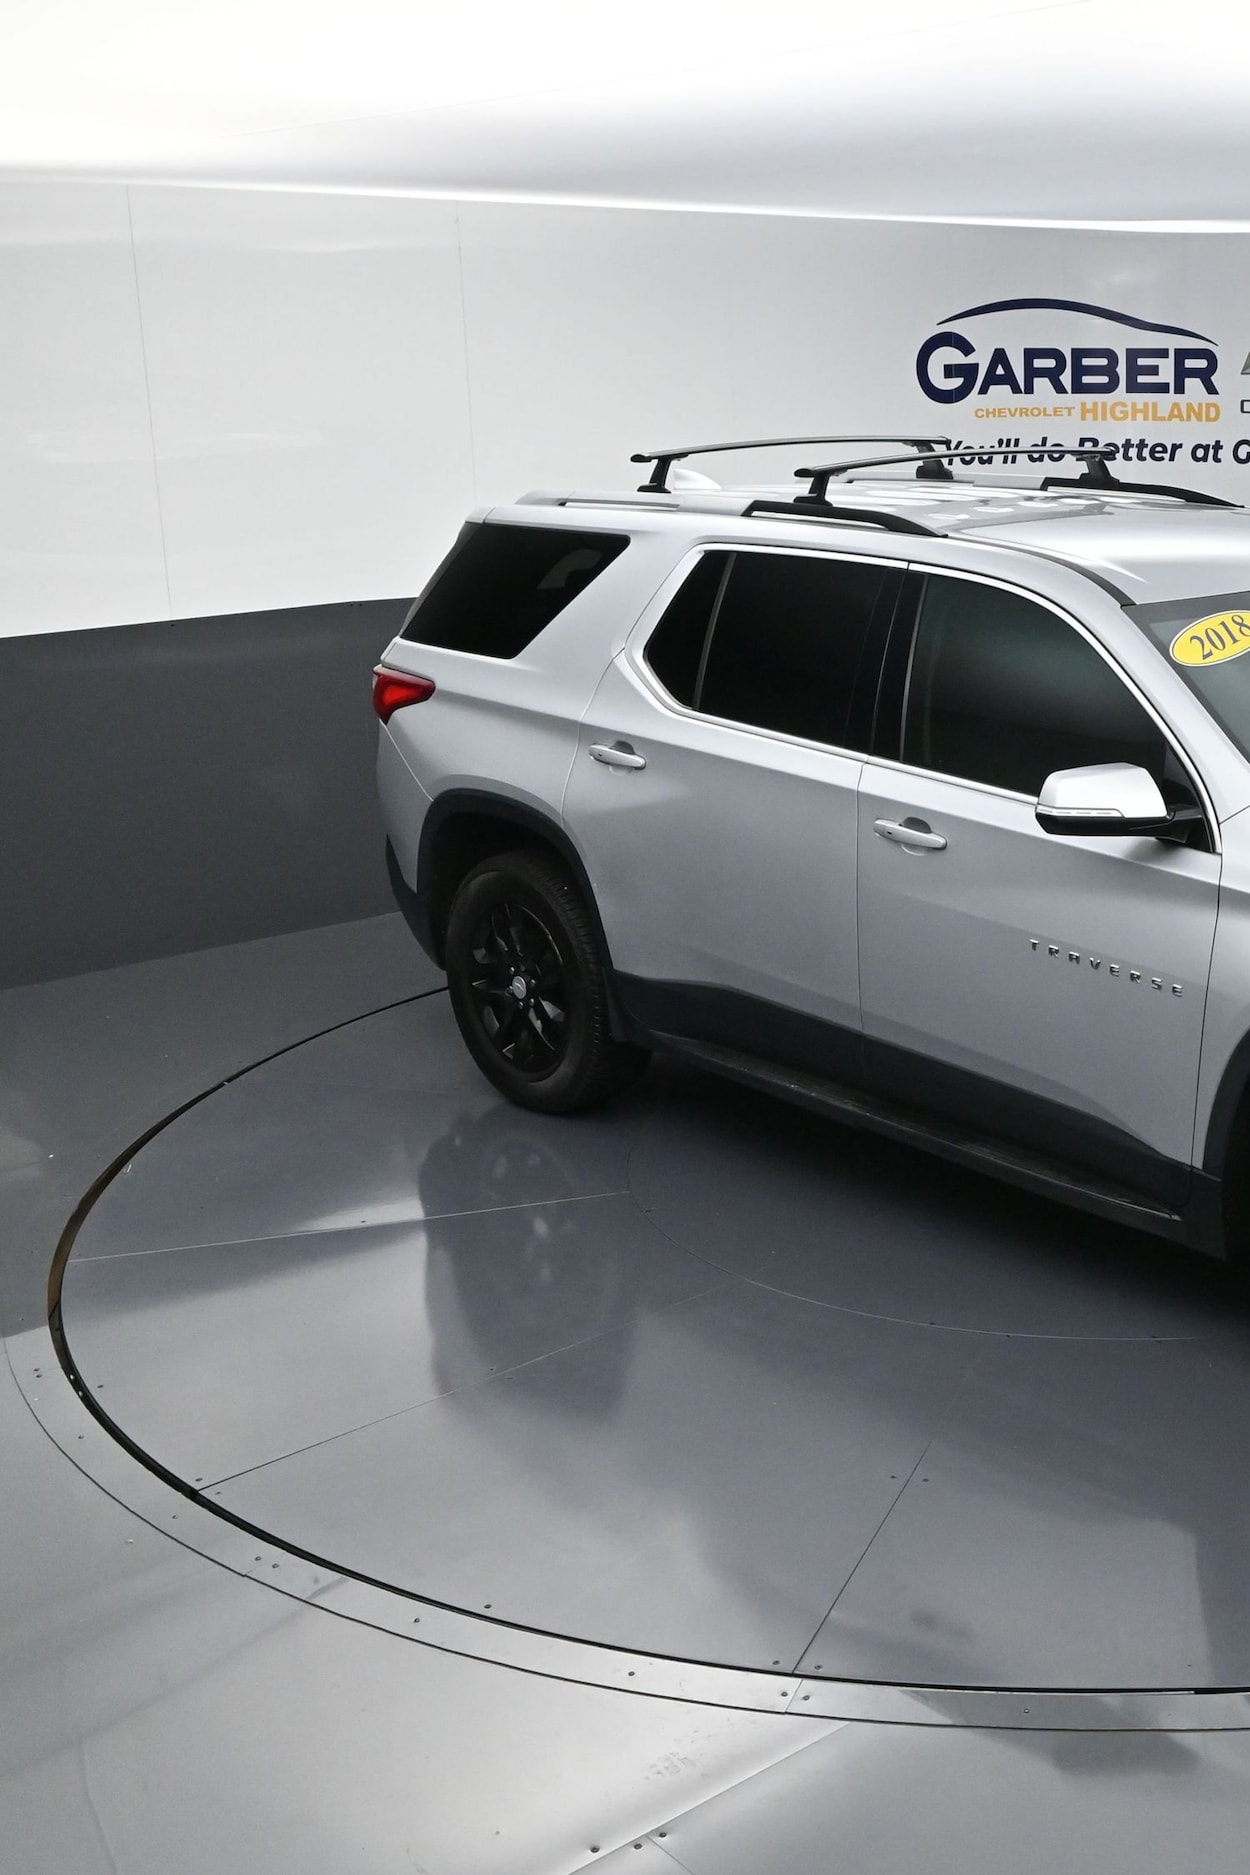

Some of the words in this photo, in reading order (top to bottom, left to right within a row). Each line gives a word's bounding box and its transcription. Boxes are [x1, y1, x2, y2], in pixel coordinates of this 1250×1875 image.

[916, 331, 1219, 404] GARBER
[974, 406, 1075, 419] CHEVROLET
[1080, 401, 1220, 422] HIGHLAND
[1027, 437, 1065, 463] do
[1190, 440, 1223, 463] at
[1029, 938, 1184, 998] TRAVERSE
